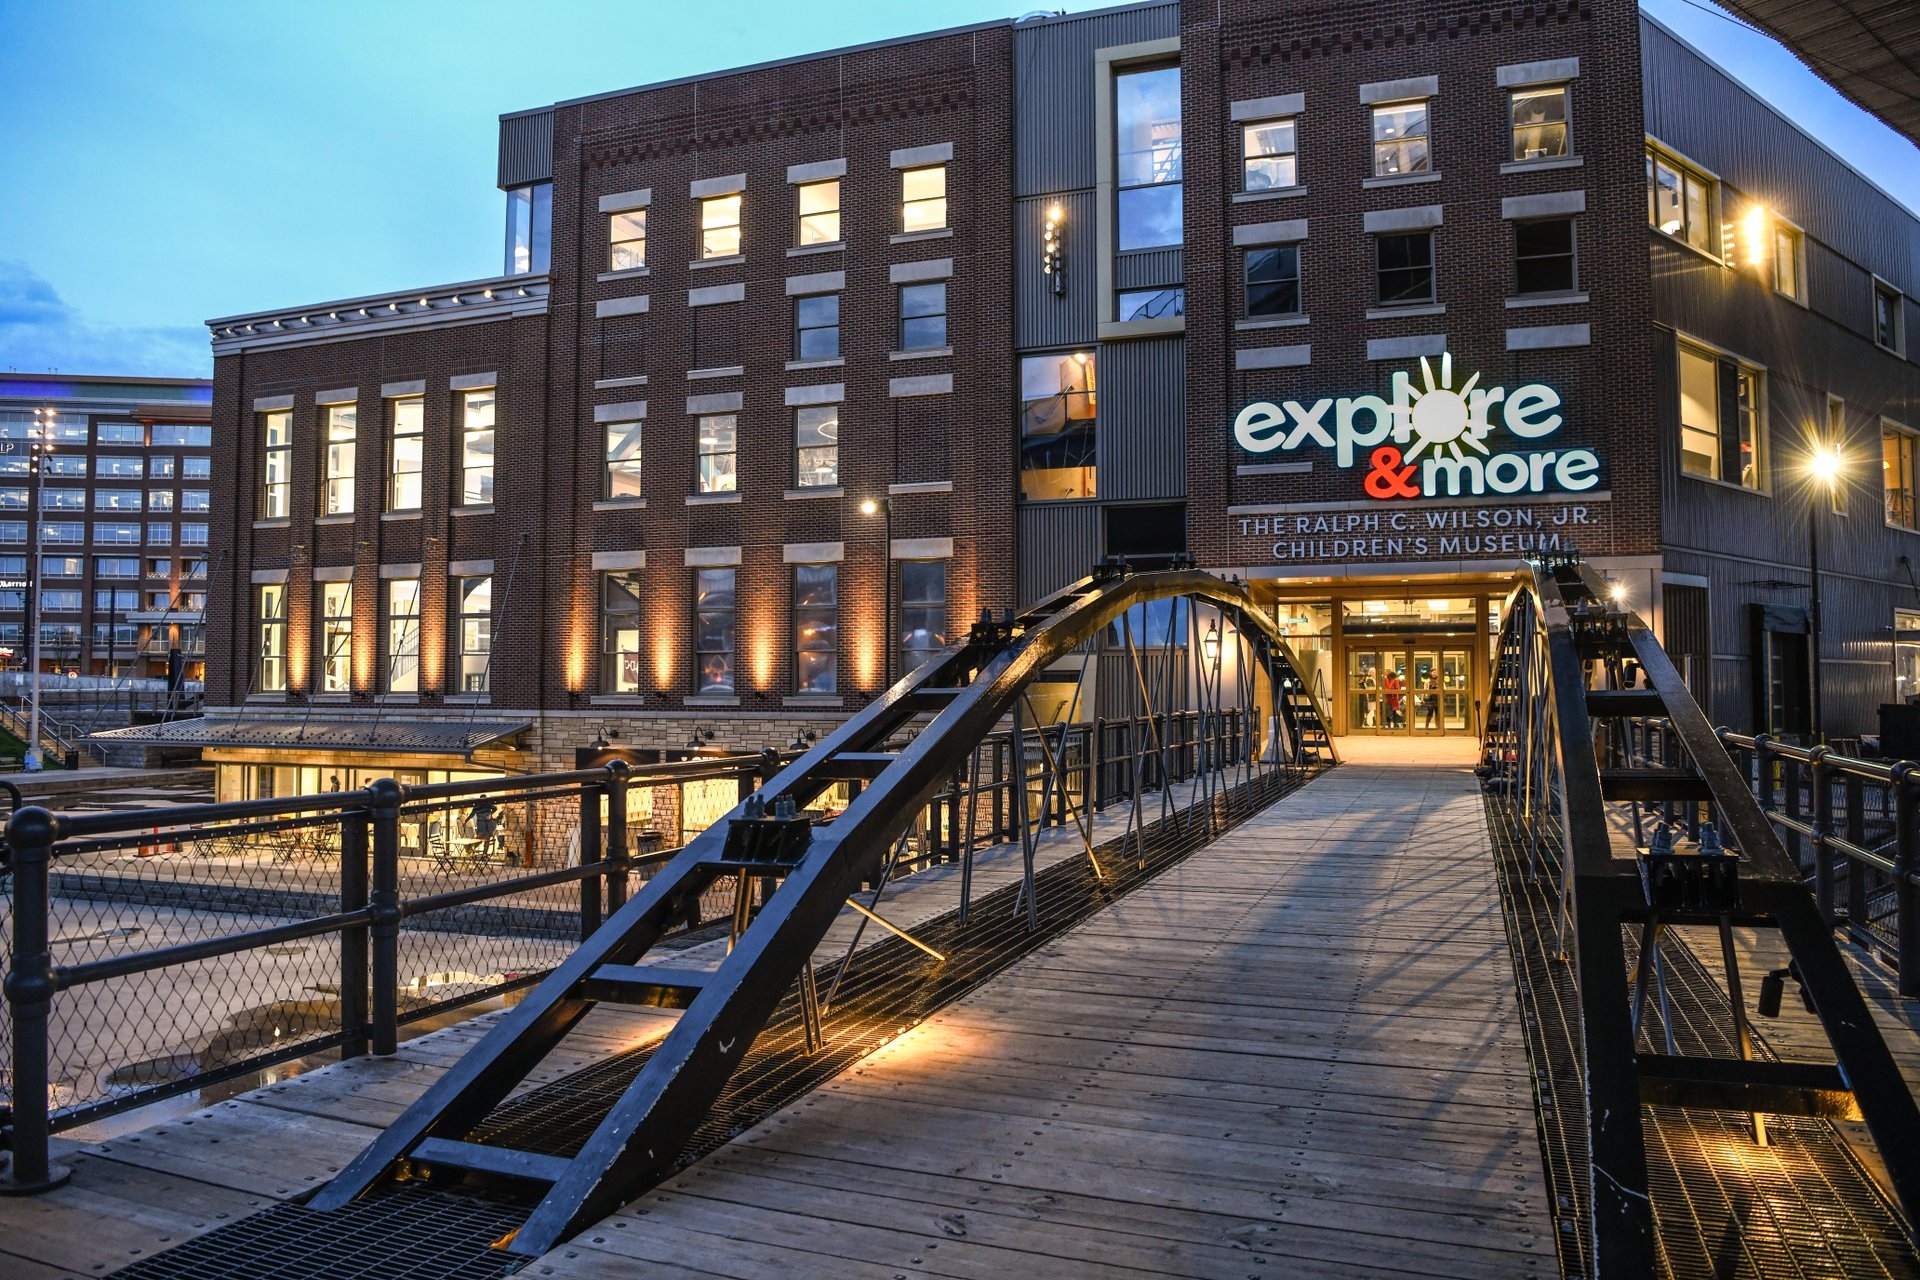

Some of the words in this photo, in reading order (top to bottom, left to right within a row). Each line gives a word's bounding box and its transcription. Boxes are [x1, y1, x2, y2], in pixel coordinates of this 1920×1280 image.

[1234, 371, 1563, 468] explore
[1239, 517, 1286, 536] THE
[1296, 514, 1379, 534] RALPH
[1391, 513, 1415, 531] C.
[1425, 508, 1542, 529] WILSON,
[1552, 506, 1598, 526] JR.
[1272, 536, 1428, 559] CHILDREN'S
[1439, 533, 1560, 556] MUSEUM
